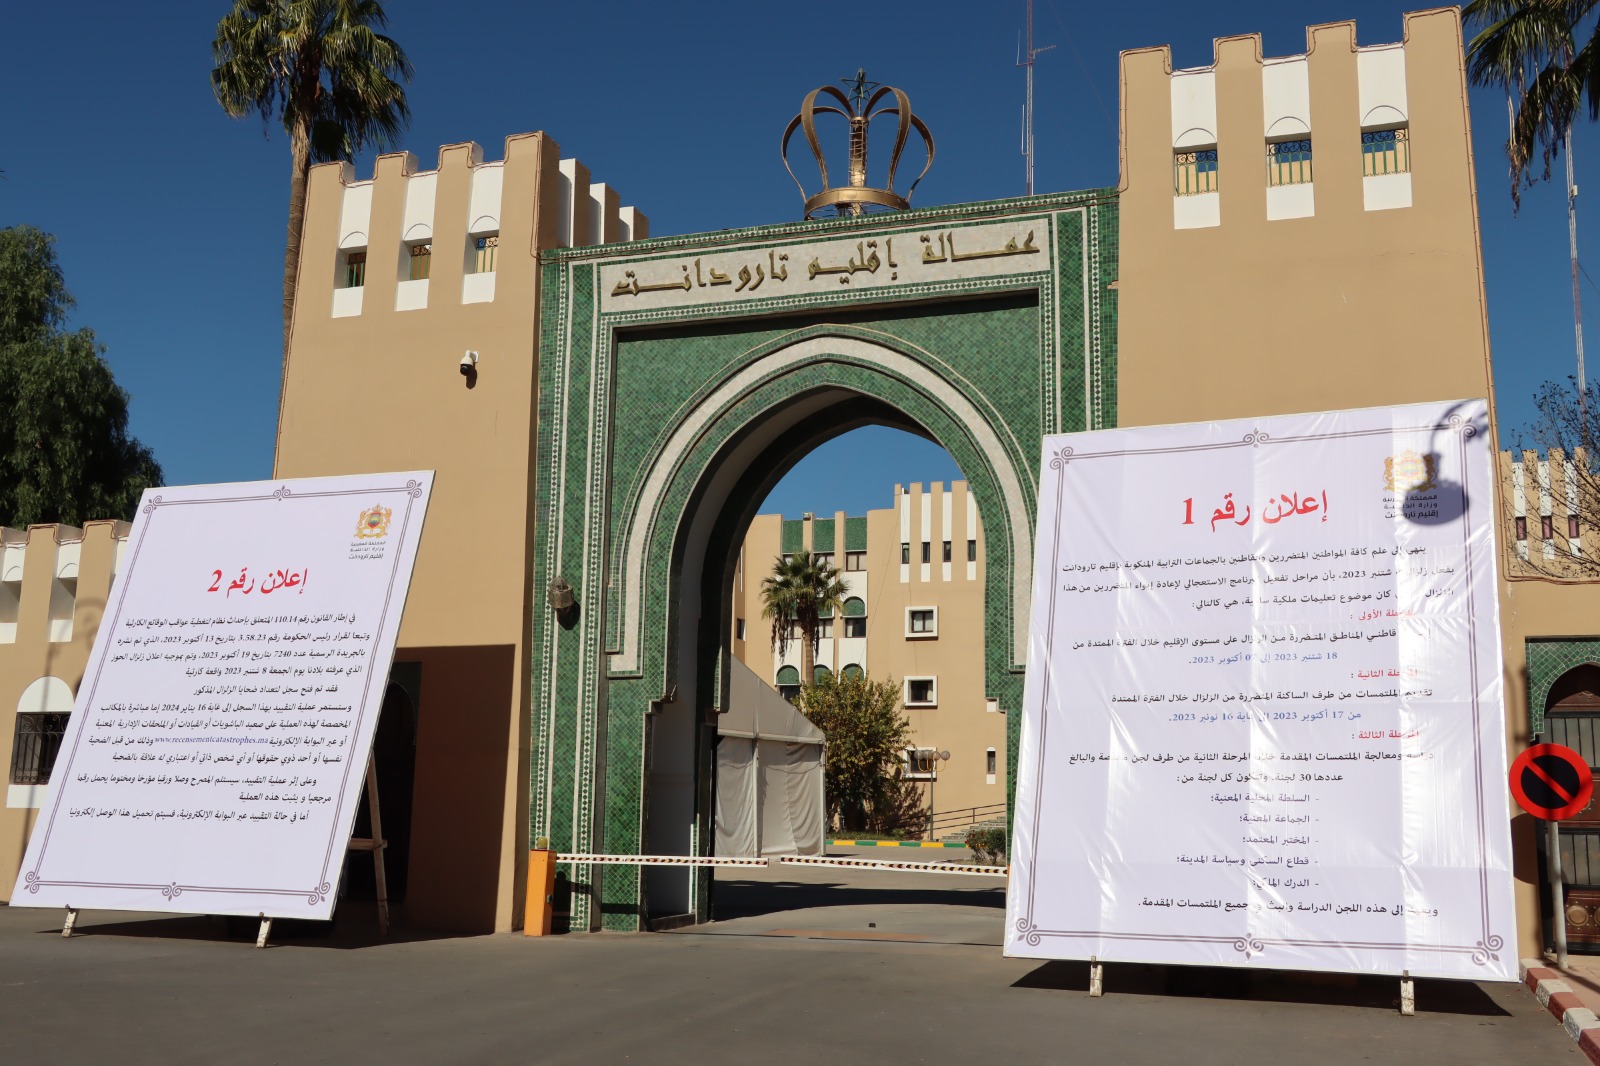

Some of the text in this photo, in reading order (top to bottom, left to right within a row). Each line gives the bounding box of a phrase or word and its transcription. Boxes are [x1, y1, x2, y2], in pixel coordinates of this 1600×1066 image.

[611, 229, 1041, 297] عمالة إقليم تارودانت
[1181, 488, 1328, 534] إعلان رقم 1
[1417, 509, 1439, 520] إقليم
[1268, 551, 1309, 563] المتضررين
[1311, 548, 1347, 561] المواطنين
[1350, 547, 1368, 556] كافة
[1371, 546, 1388, 559] علم
[1124, 559, 1154, 571] المنكوبة
[1156, 558, 1182, 569] الترابية
[1184, 555, 1226, 566] بالجماعات
[1062, 563, 1097, 573] تارودانت
[1369, 568, 1393, 580] شتنبر
[1263, 574, 1289, 585] تفعيل
[1291, 572, 1319, 583] مراحل
[1321, 569, 1336, 582] بأن
[206, 566, 308, 599] إعلان رقم 2
[1063, 583, 1078, 592] هذا
[1156, 579, 1181, 590] لإعادة
[1183, 577, 1227, 591] الاستعجالي
[1078, 585, 1091, 594] من
[1375, 589, 1392, 601] كان
[1223, 599, 1239, 609] هي
[1272, 595, 1297, 606] ملكية
[1300, 593, 1336, 604] تعليمات
[1339, 592, 1373, 604] موضوع
[250, 613, 334, 626] القانون رقم 110.14 المتعلق
[1358, 608, 1383, 622] الأولى
[181, 632, 312, 646] الحكومة رقم 3.58.23 بتاريخ 13 أكتوبر
[1072, 628, 1397, 651] قاطني المناطق المتضررة من على مستوى الإقليم خلال الممتدة من
[218, 648, 241, 661] أكتوبر
[241, 650, 251, 659] 19
[273, 650, 292, 658] 7240
[308, 648, 336, 660] الرسمية
[336, 648, 366, 659] بالجريدة
[1217, 652, 1243, 665] أكتوبر
[1274, 653, 1298, 661] 2023
[1300, 652, 1323, 663] شتنبر
[1326, 651, 1338, 660] 18
[223, 666, 306, 678] يوم الجمعة 8 2023
[1357, 669, 1384, 681] الثانية
[281, 685, 299, 695] سجل
[1111, 688, 1401, 704] الملتمسات من طرف الساكنة المتضررة من الزلزال خلال الفترة الممتدة
[161, 702, 317, 713] عملية السجل 16 2024
[1198, 713, 1218, 724] نونبر
[1222, 712, 1234, 721] 16
[1273, 711, 1298, 720] 2023
[1300, 708, 1328, 722] أكتوبر
[1332, 710, 1344, 719] 17
[1347, 711, 1362, 721] من
[168, 717, 303, 731] العملية على أو أو
[1358, 730, 1385, 739] الثالثة
[124, 734, 348, 748] أو www.recensementcatastrophes.ma من
[189, 750, 322, 765] أو أو أو
[1068, 751, 1403, 765] ومعالجة الملتمسات المقدمة المرحلة الثانية من طرف لجن والبالغ
[267, 775, 288, 787] عملية
[1181, 774, 1195, 784] من
[1197, 772, 1218, 784] لجنة
[1220, 772, 1234, 783] كل
[1299, 773, 1312, 782] 30
[1313, 773, 1344, 782] عددها
[238, 791, 280, 803] هذه العملية
[1244, 792, 1274, 804] المحلية
[1277, 793, 1310, 803] السلطة
[95, 808, 288, 820] حالة هذا الوصل
[1274, 814, 1310, 826] الجماعة
[1281, 835, 1310, 847] المختبر
[1211, 854, 1246, 867] وسياسة
[1286, 856, 1310, 869] قطاع
[1283, 878, 1310, 890] الدرك
[1176, 898, 1222, 909] الملتمسات
[1224, 902, 1249, 913] جميع
[1297, 901, 1332, 914] الدراسة
[1335, 903, 1363, 915] اللجن
[1365, 903, 1388, 913] هذه
[1391, 904, 1404, 917] إلى
